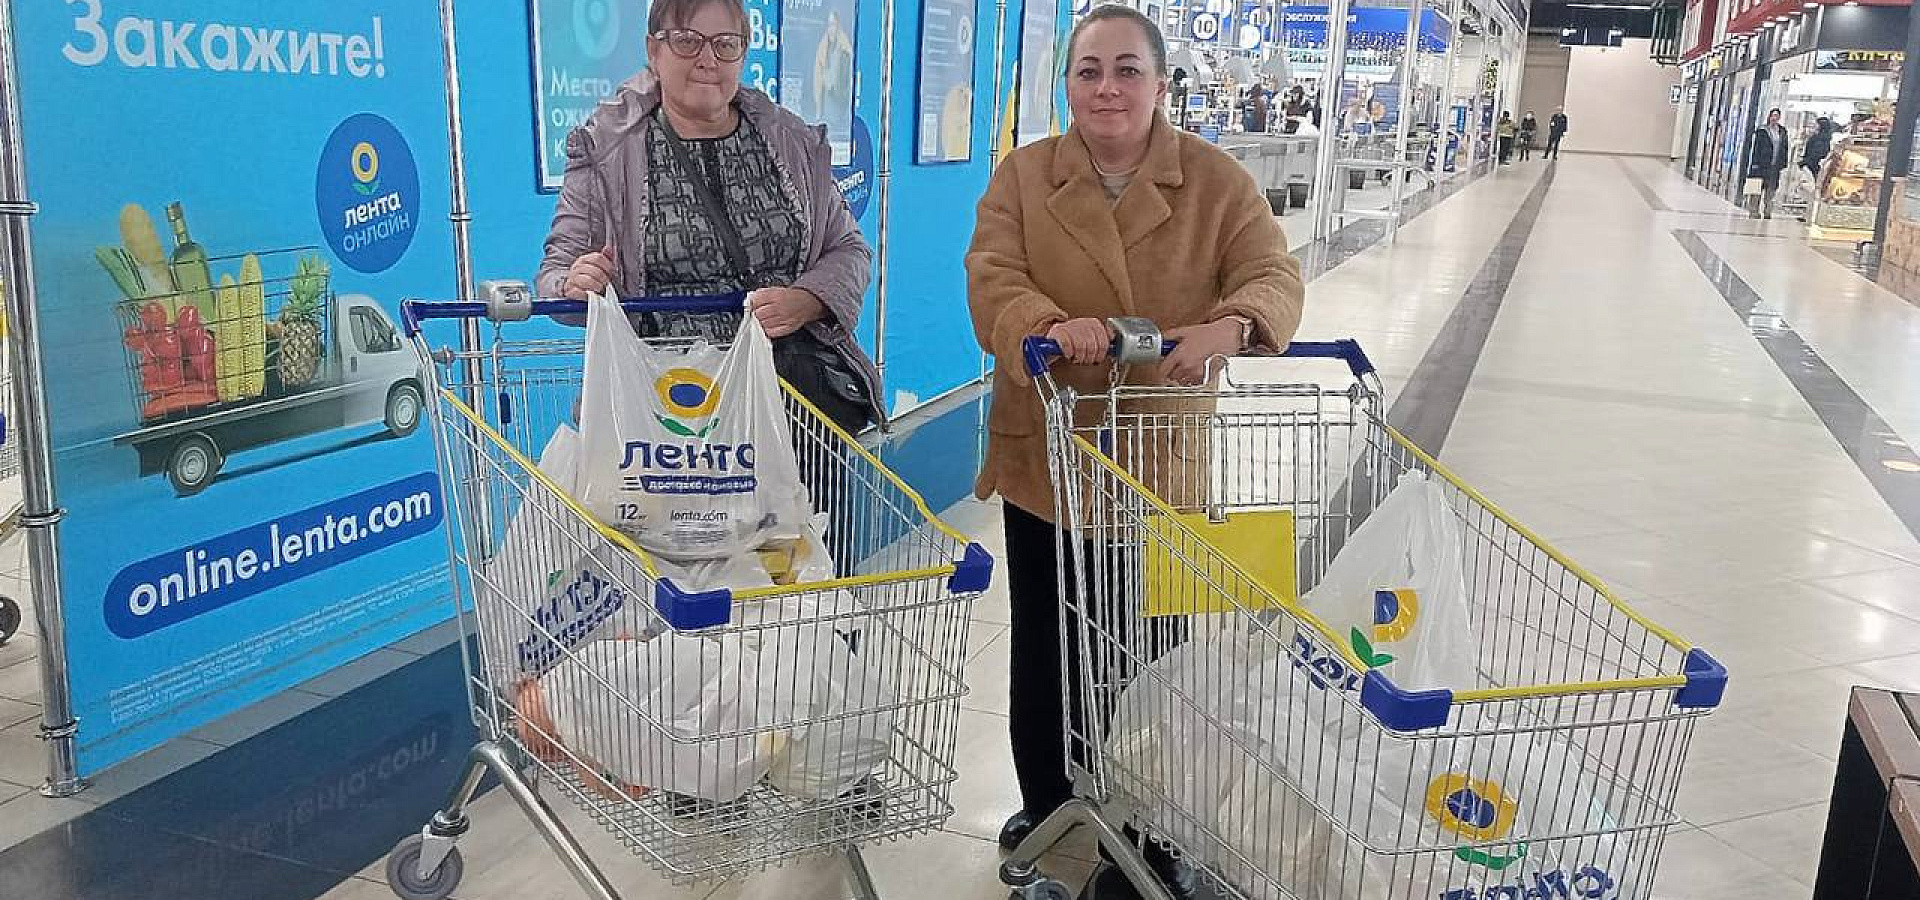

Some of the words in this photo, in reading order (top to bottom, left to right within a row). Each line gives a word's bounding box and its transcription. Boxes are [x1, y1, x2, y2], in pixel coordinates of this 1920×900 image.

[61, 0, 386, 78] Закажите!
[1197, 19, 1213, 34] 10
[550, 66, 612, 97] Место
[344, 192, 401, 229] лента
[343, 211, 410, 252] онлайн
[618, 503, 639, 520] 12
[670, 509, 729, 522] lenta.com
[129, 490, 432, 616] online.lenta.com
